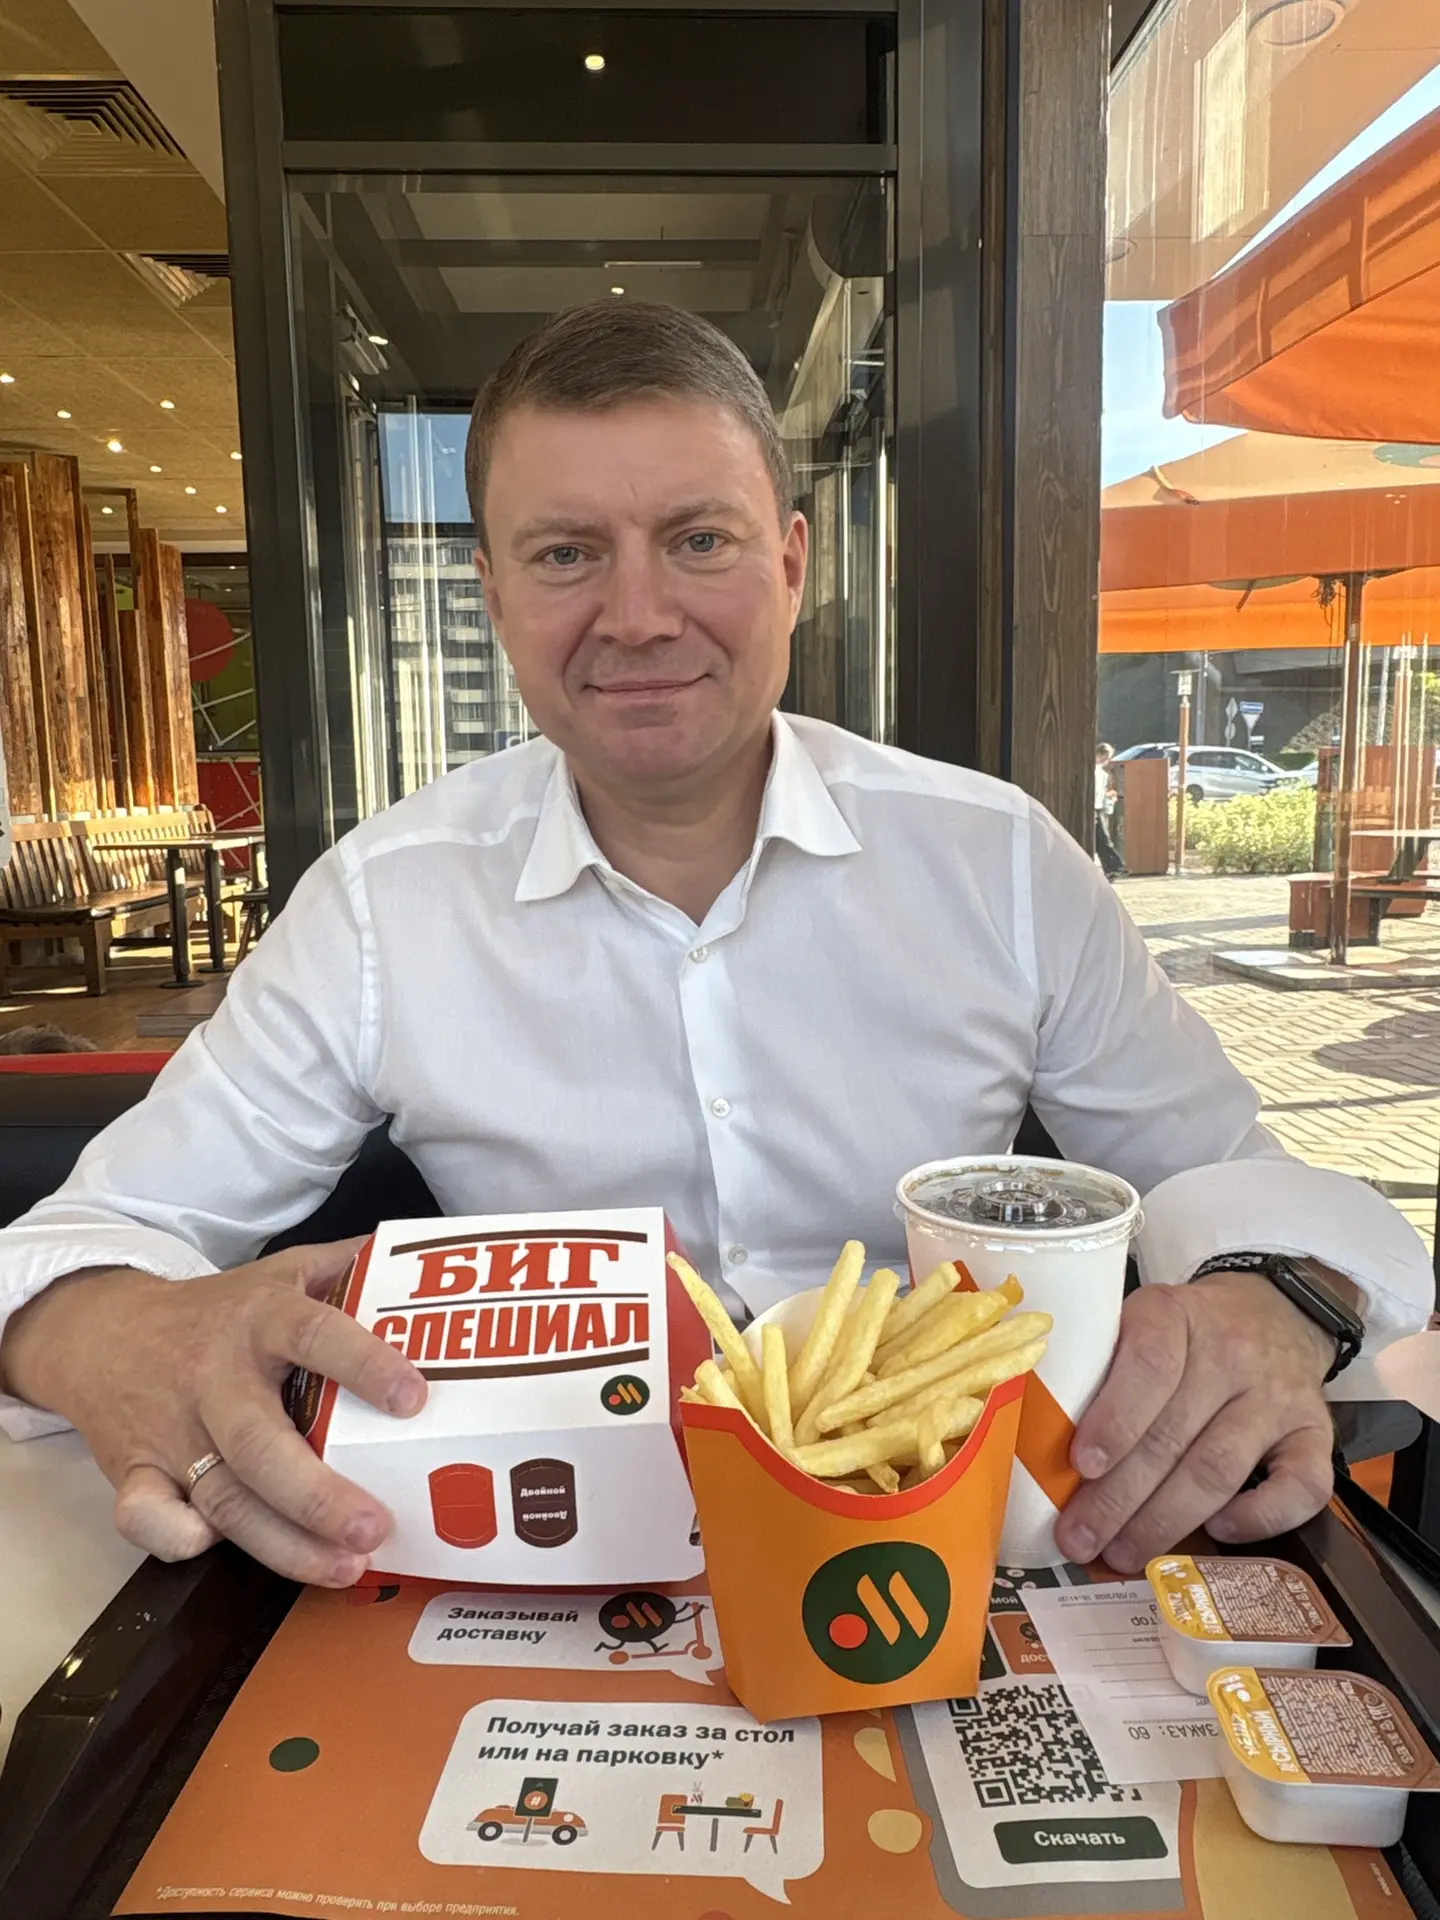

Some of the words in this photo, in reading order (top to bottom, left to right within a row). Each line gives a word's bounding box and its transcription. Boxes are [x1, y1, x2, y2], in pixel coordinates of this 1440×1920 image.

[409, 1241, 619, 1299] БИГ
[520, 1485, 566, 1498] Двойной
[447, 1607, 579, 1623] Заказывай
[438, 1627, 547, 1644] доставку
[486, 1716, 600, 1739] Получай
[607, 1723, 688, 1739] заказ
[695, 1726, 727, 1741] за
[735, 1728, 795, 1743] стол
[1158, 1723, 1219, 1739] ЗАКАЗ:
[478, 1745, 527, 1761] или
[535, 1747, 569, 1763] на
[1033, 1830, 1126, 1847] Скачать
[228, 1887, 275, 1900] сервиса
[276, 1889, 313, 1903] можно
[316, 1893, 373, 1910] проверить
[376, 1900, 398, 1913] при
[401, 1900, 443, 1915] выборе
